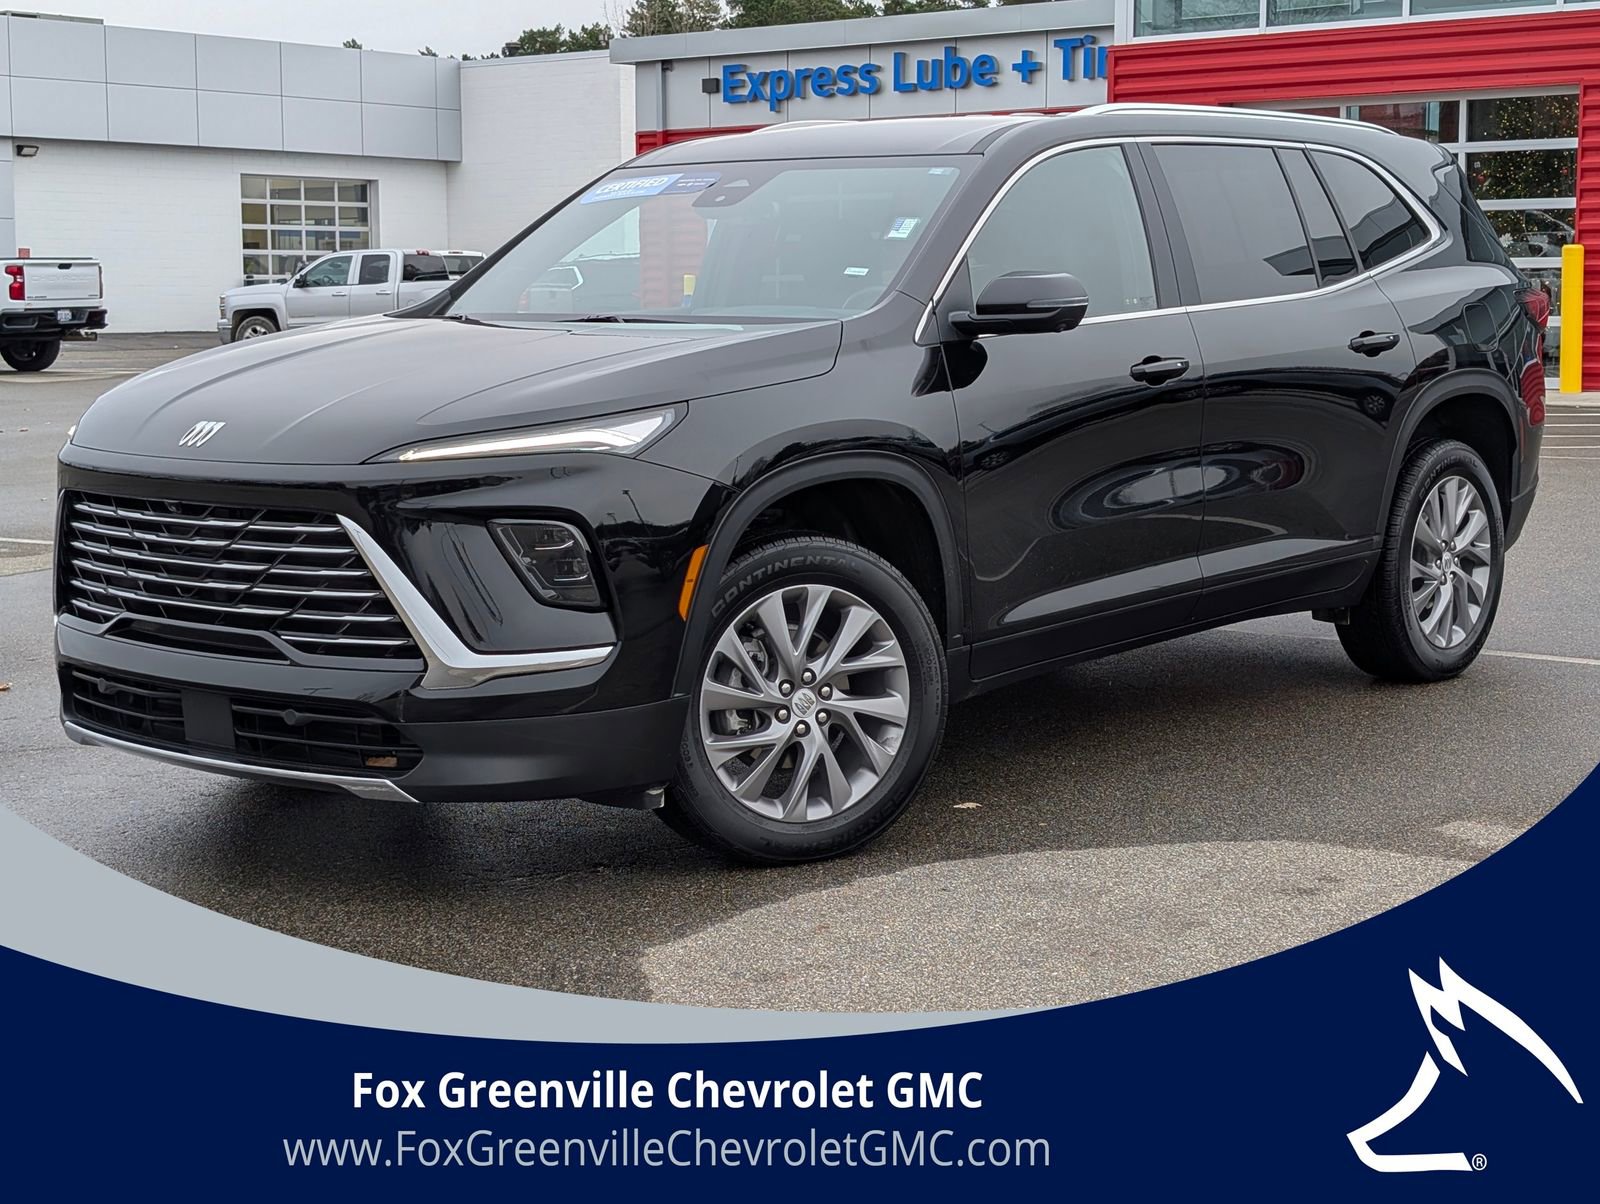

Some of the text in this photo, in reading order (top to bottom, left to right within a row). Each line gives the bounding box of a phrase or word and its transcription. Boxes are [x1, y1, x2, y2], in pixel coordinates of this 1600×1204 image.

[722, 63, 879, 112] Express
[893, 46, 997, 93] Lube
[711, 554, 863, 619] CONTINENTAL
